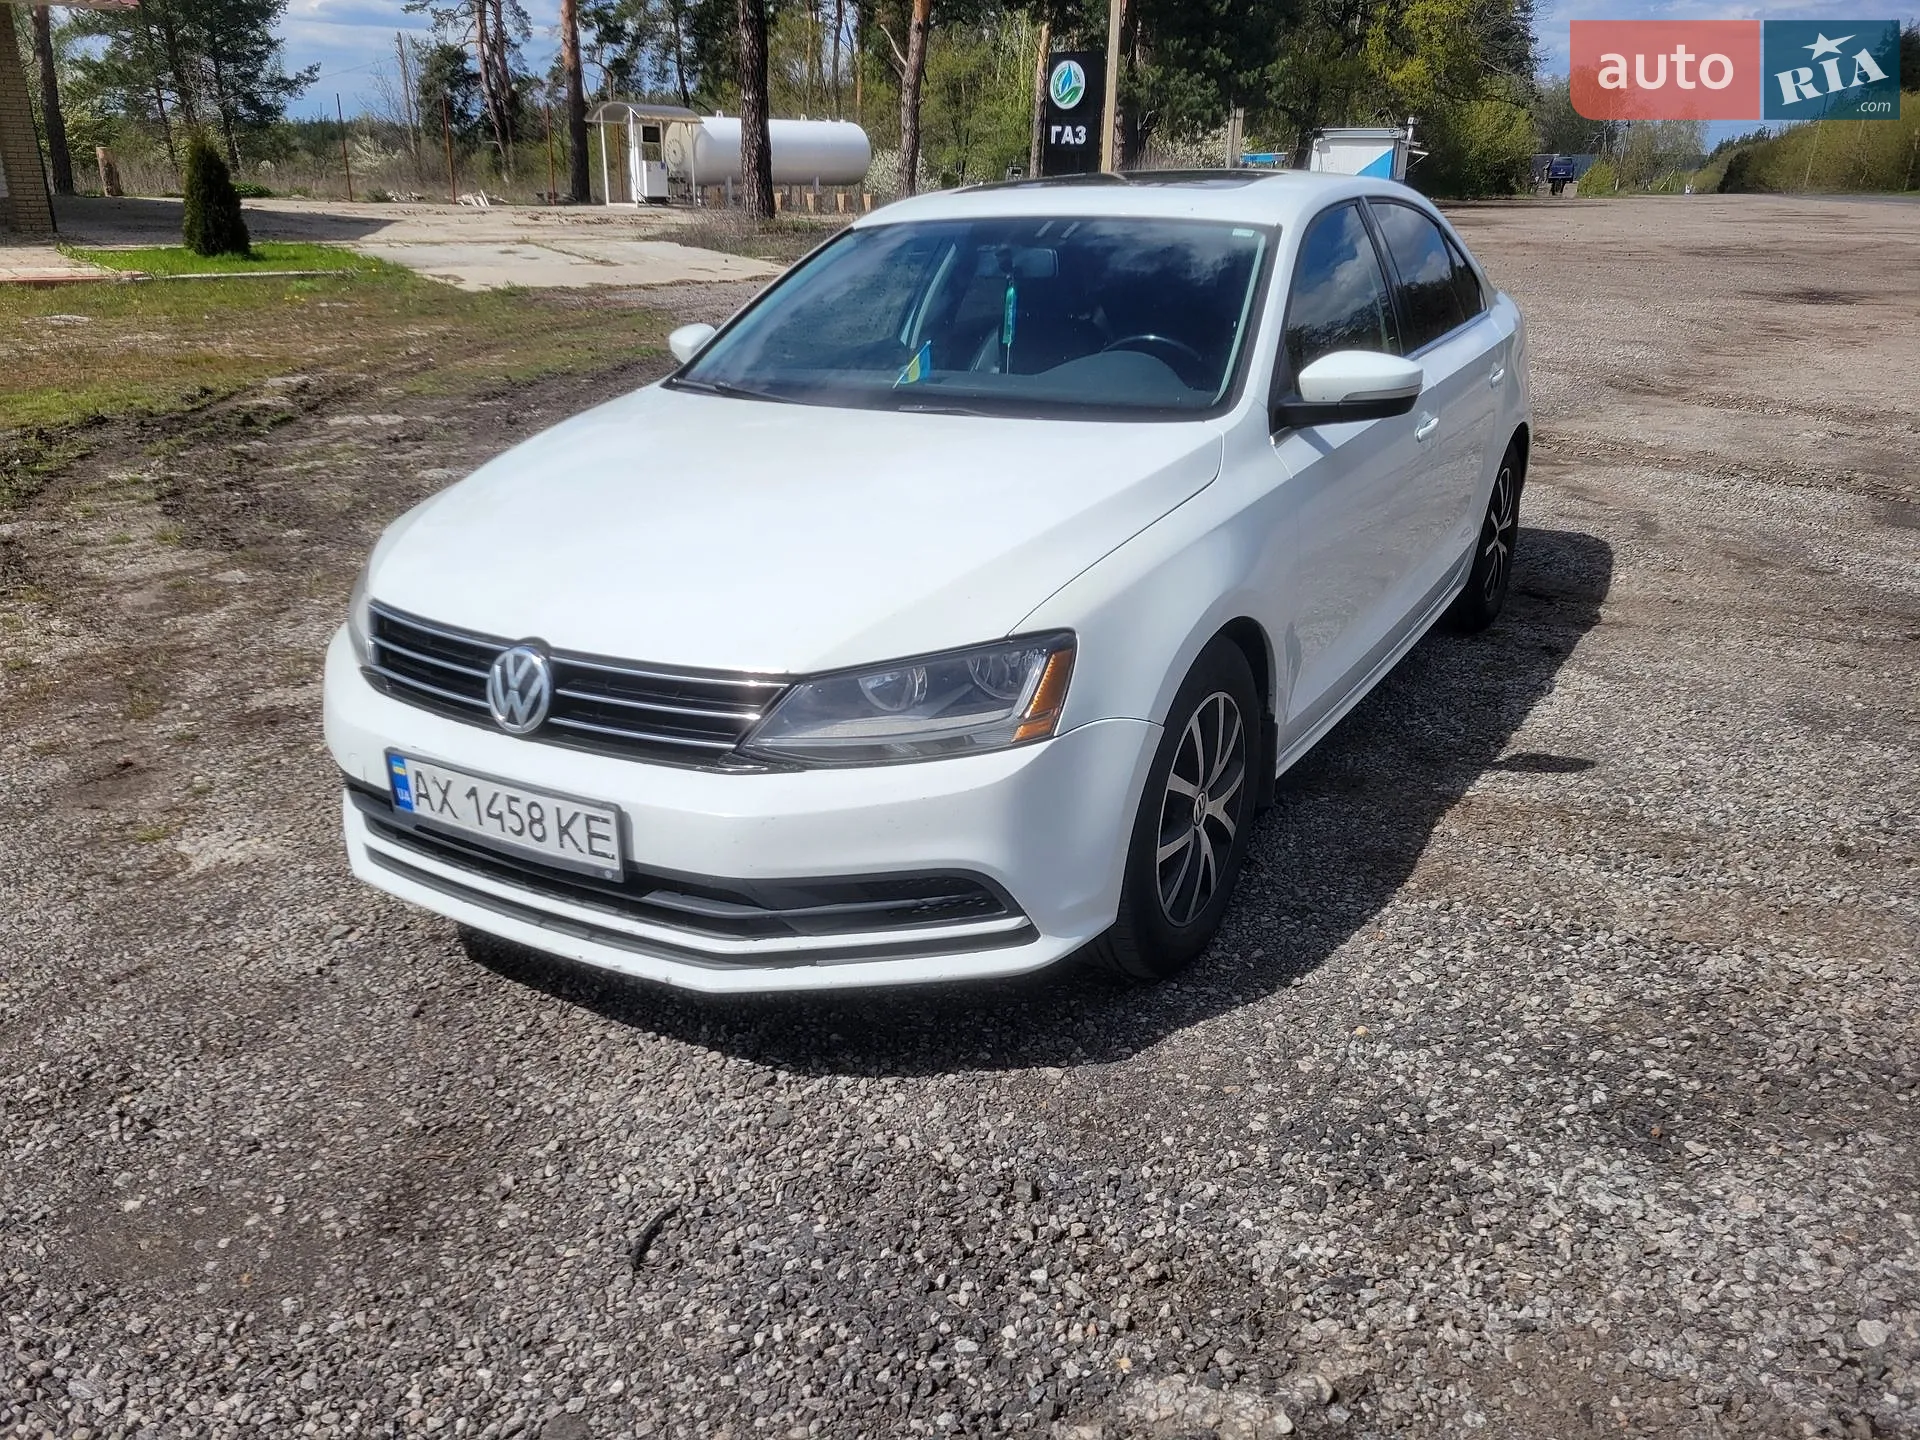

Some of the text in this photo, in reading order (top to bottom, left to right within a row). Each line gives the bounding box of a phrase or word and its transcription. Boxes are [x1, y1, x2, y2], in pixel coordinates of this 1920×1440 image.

[1050, 125, 1087, 145] ГАЗ
[414, 769, 617, 861] AX 1458 KE
